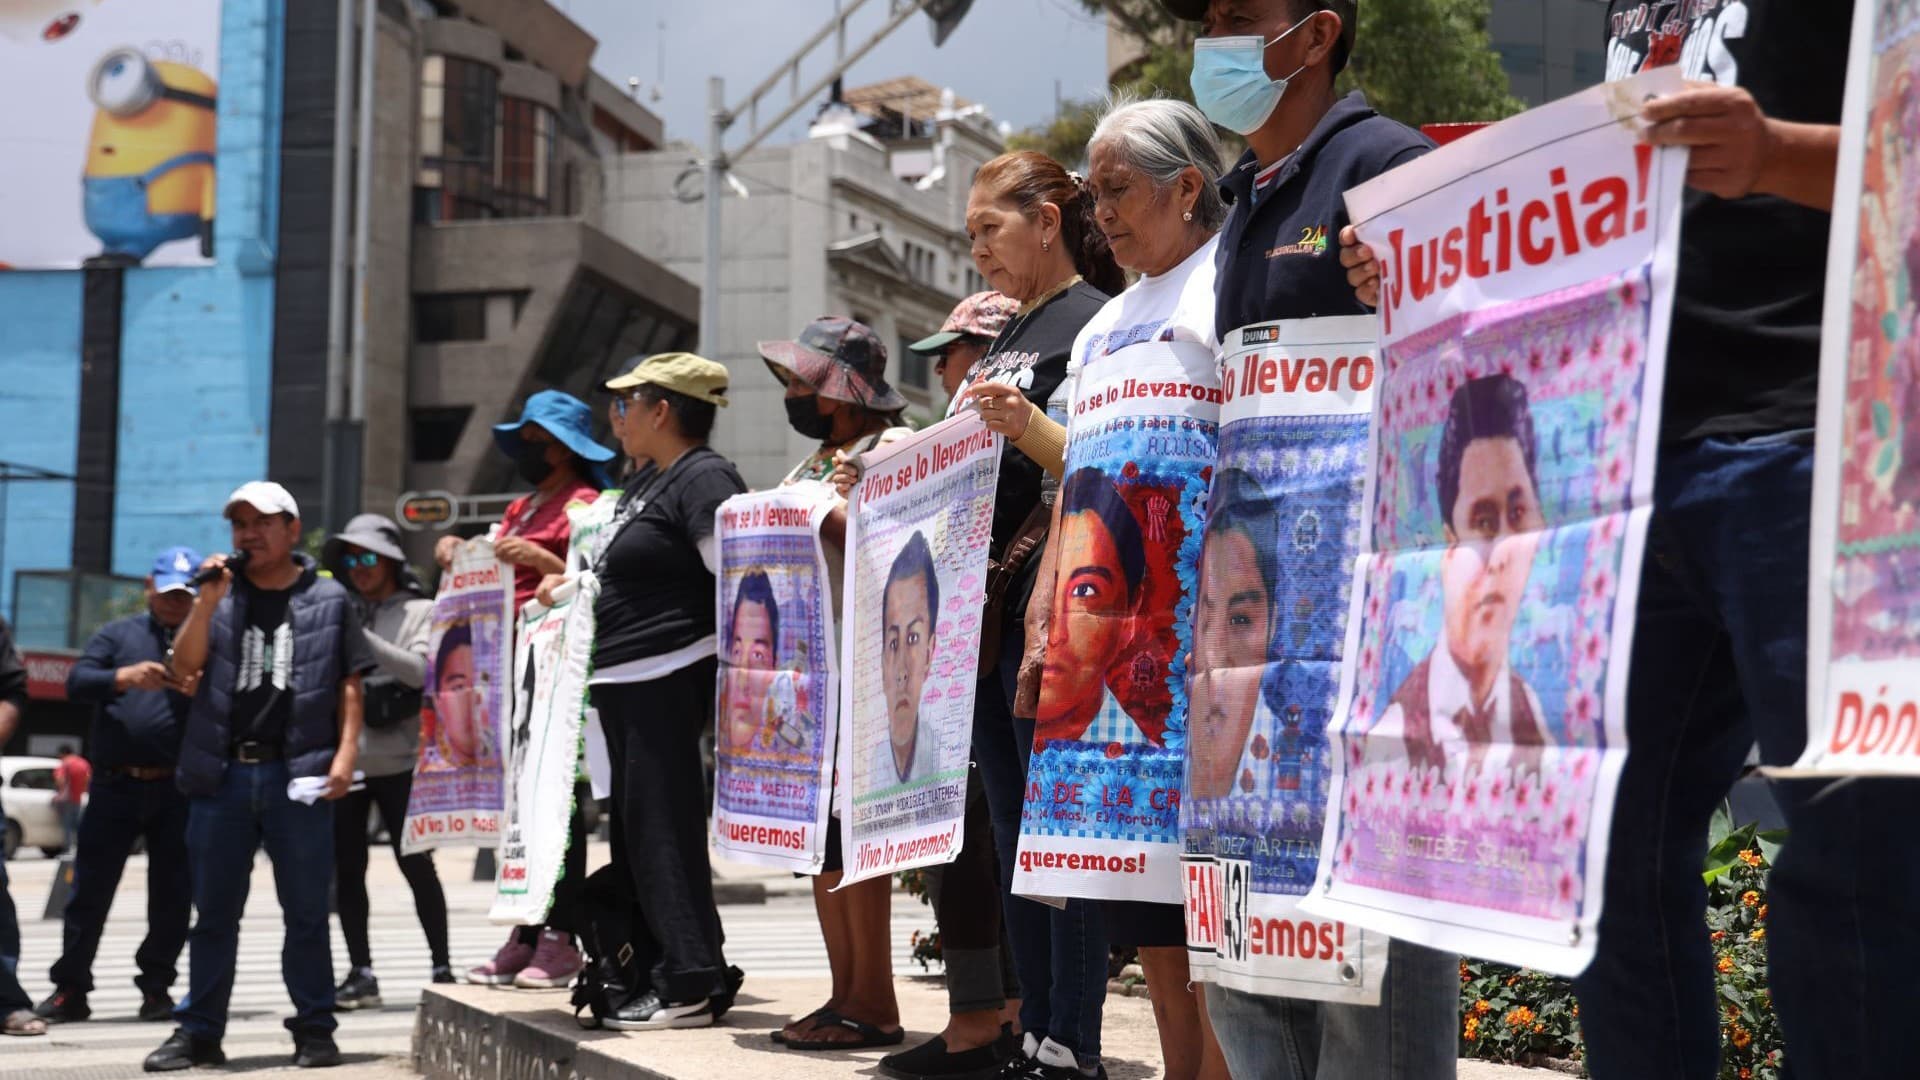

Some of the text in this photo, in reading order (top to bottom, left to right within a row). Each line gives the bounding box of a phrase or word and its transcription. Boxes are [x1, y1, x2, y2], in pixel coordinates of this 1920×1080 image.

[1379, 143, 1653, 336] ¡Justicia!
[1240, 353, 1374, 397] llevaro
[1089, 393, 1103, 411] se
[1106, 385, 1118, 405] lo
[1121, 378, 1224, 405] llevaron
[1142, 418, 1175, 430] saber
[857, 472, 892, 513] ¡Vivo
[896, 465, 912, 491] se
[916, 453, 928, 482] lo
[932, 428, 992, 474] llevaron!
[1829, 684, 1920, 756] Dón
[760, 782, 806, 800] MAESTRO
[1054, 782, 1083, 805] DE
[1102, 785, 1133, 808] LA
[1150, 788, 1181, 811] CR
[448, 815, 464, 833] lo
[726, 823, 805, 851] ueremos!
[854, 842, 882, 877] ¡Vivo
[883, 839, 894, 865] lo
[895, 823, 956, 866] queremos!
[1019, 850, 1146, 874] queremos!
